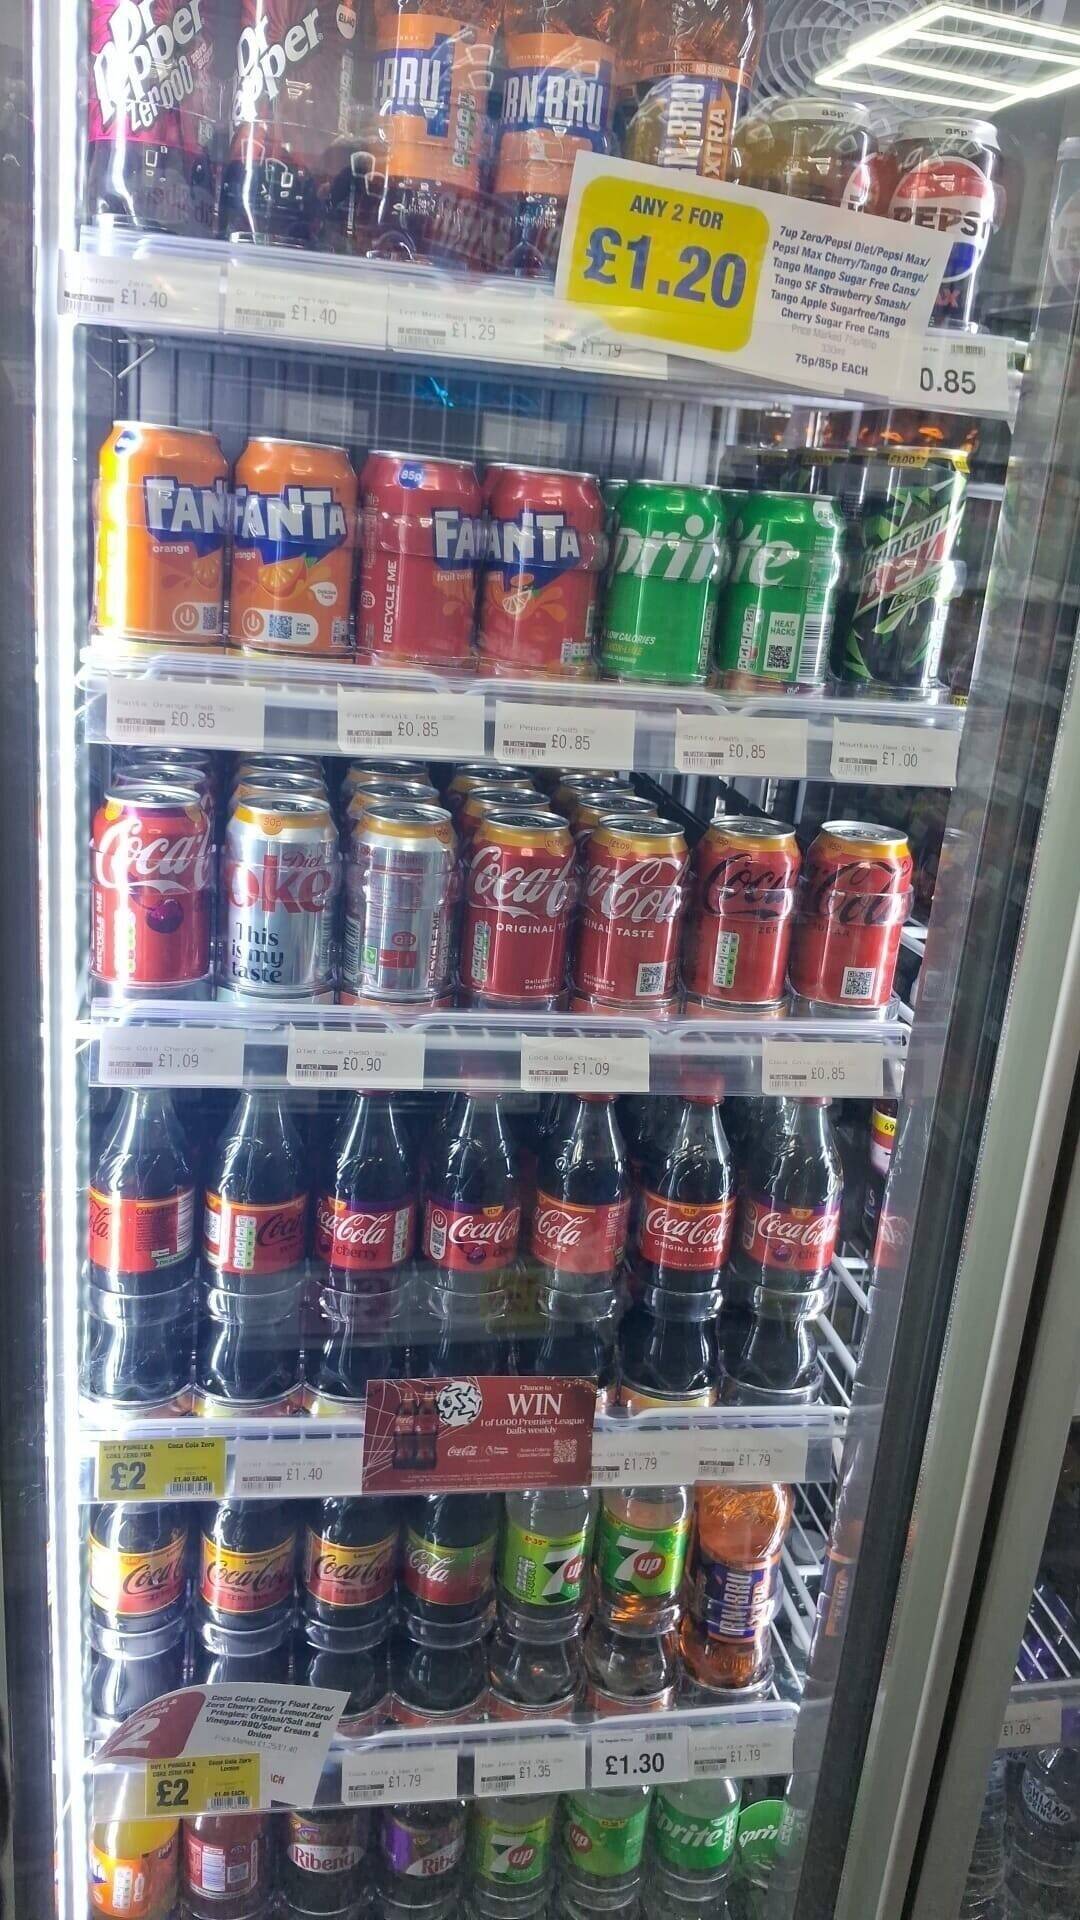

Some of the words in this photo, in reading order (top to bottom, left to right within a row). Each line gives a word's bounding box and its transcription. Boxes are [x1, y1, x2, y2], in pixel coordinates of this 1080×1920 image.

[703, 109, 726, 177] XTRA
[630, 195, 669, 218] ANY
[672, 203, 684, 222] 2
[689, 210, 723, 230] FOR
[780, 226, 798, 239] 7up
[800, 231, 852, 250] Zero/Pepsi
[854, 242, 903, 261] Diet/Pepsi
[905, 252, 931, 267] Max/
[584, 227, 747, 309] £1.20
[772, 241, 799, 256] Pepsi
[802, 247, 822, 262] Max
[825, 252, 887, 274] Cherry/Tango
[890, 266, 928, 283] Orange/
[773, 257, 800, 272] Tango
[804, 264, 836, 280] Mango
[839, 272, 866, 286] Sugar
[869, 278, 889, 291] Free
[892, 283, 920, 296] Cans/
[120, 289, 168, 308] £1.40
[775, 274, 801, 289] Tango
[805, 280, 817, 291] SF
[819, 283, 872, 304] Strawberry
[875, 295, 911, 310] Smash/
[291, 305, 337, 325] £1.40
[771, 289, 798, 304] Tango
[801, 296, 827, 310] Apple
[830, 301, 906, 327] Sugarfree/Tango
[452, 322, 496, 341] £1.29
[781, 308, 812, 324] Cherry
[815, 314, 843, 328] Sugar
[845, 321, 865, 333] Free
[868, 326, 890, 339] Cans
[796, 353, 838, 371] 75p/85p
[841, 363, 869, 376] EACH
[920, 367, 976, 395] 0.85
[400, 470, 422, 481] 85p
[152, 545, 190, 555] orange
[387, 560, 397, 582] ME
[383, 583, 396, 644] RECYCLE
[770, 627, 796, 636] HACKS
[775, 620, 795, 629] HEAT
[619, 632, 656, 645] CALORIES
[171, 711, 215, 728] £0.85
[398, 721, 439, 737] £0.85
[551, 734, 590, 750] £0.85
[728, 744, 766, 760] £0.85
[882, 752, 918, 768] £1.00
[236, 922, 280, 945] This
[497, 923, 554, 934] ORIGINAL
[617, 928, 656, 938] TASTE
[249, 951, 284, 972] my
[232, 961, 282, 984] taste
[159, 1053, 199, 1068] £1.09
[343, 1057, 381, 1071] £0.90
[573, 1062, 609, 1076] £1.09
[811, 1067, 845, 1080] £0.85
[655, 1240, 694, 1253] ORIGINAL
[508, 1393, 562, 1416] WIN
[485, 1419, 496, 1427] of
[519, 1418, 553, 1426] Premier
[554, 1417, 585, 1426] League
[506, 1426, 527, 1435] balls
[528, 1426, 557, 1435] weekly
[447, 1445, 478, 1457] Coca-Cola
[624, 1457, 657, 1471] £1.79
[738, 1453, 771, 1467] £1.79
[111, 1461, 146, 1490] £2
[286, 1467, 323, 1481] £1.40
[227, 1703, 277, 1713] Cherry/Zero
[280, 1707, 333, 1720] Lemon/Zero/
[259, 1697, 287, 1706] Cherry
[289, 1700, 311, 1708] Float
[312, 1703, 335, 1712] Zero/
[250, 1713, 303, 1725] Original/Salt
[248, 1730, 272, 1740] Onion
[284, 1726, 311, 1736] Cream
[1003, 1725, 1031, 1736] £1.09
[605, 1752, 665, 1775] £1.30
[731, 1750, 761, 1763] £1.19
[270, 1773, 285, 1784] CH
[519, 1765, 551, 1779] £1.35
[389, 1774, 421, 1788] £1.79
[156, 1779, 189, 1807] £2
